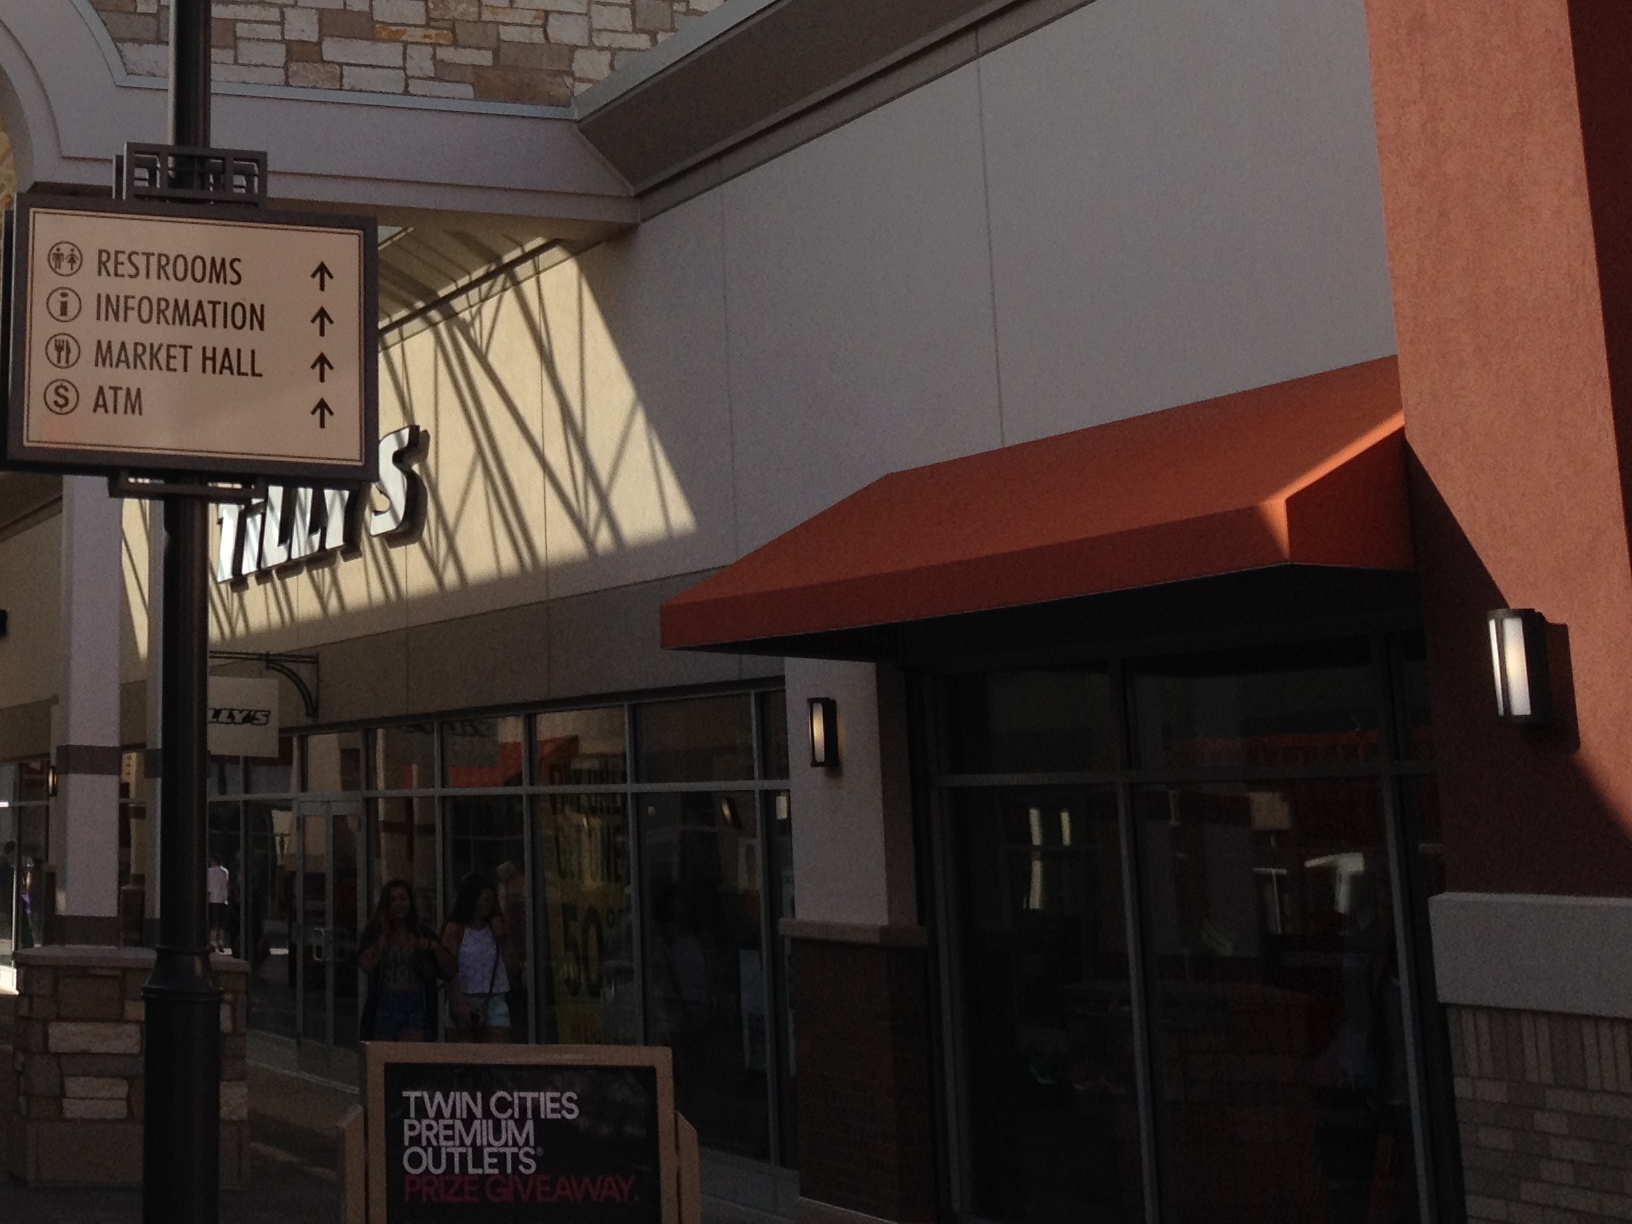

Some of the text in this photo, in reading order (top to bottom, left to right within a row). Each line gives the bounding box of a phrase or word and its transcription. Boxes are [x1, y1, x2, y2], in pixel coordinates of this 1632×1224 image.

[97, 248, 243, 286] RESTROOMS
[95, 292, 265, 332] INFORMATION
[94, 339, 264, 378] MARKET HALL
[92, 384, 144, 416] ATM
[402, 1090, 580, 1120] TWIN CITIES
[403, 1119, 536, 1148] PREMIUM
[404, 1175, 641, 1204] PRIZE GIVEAWAY.
